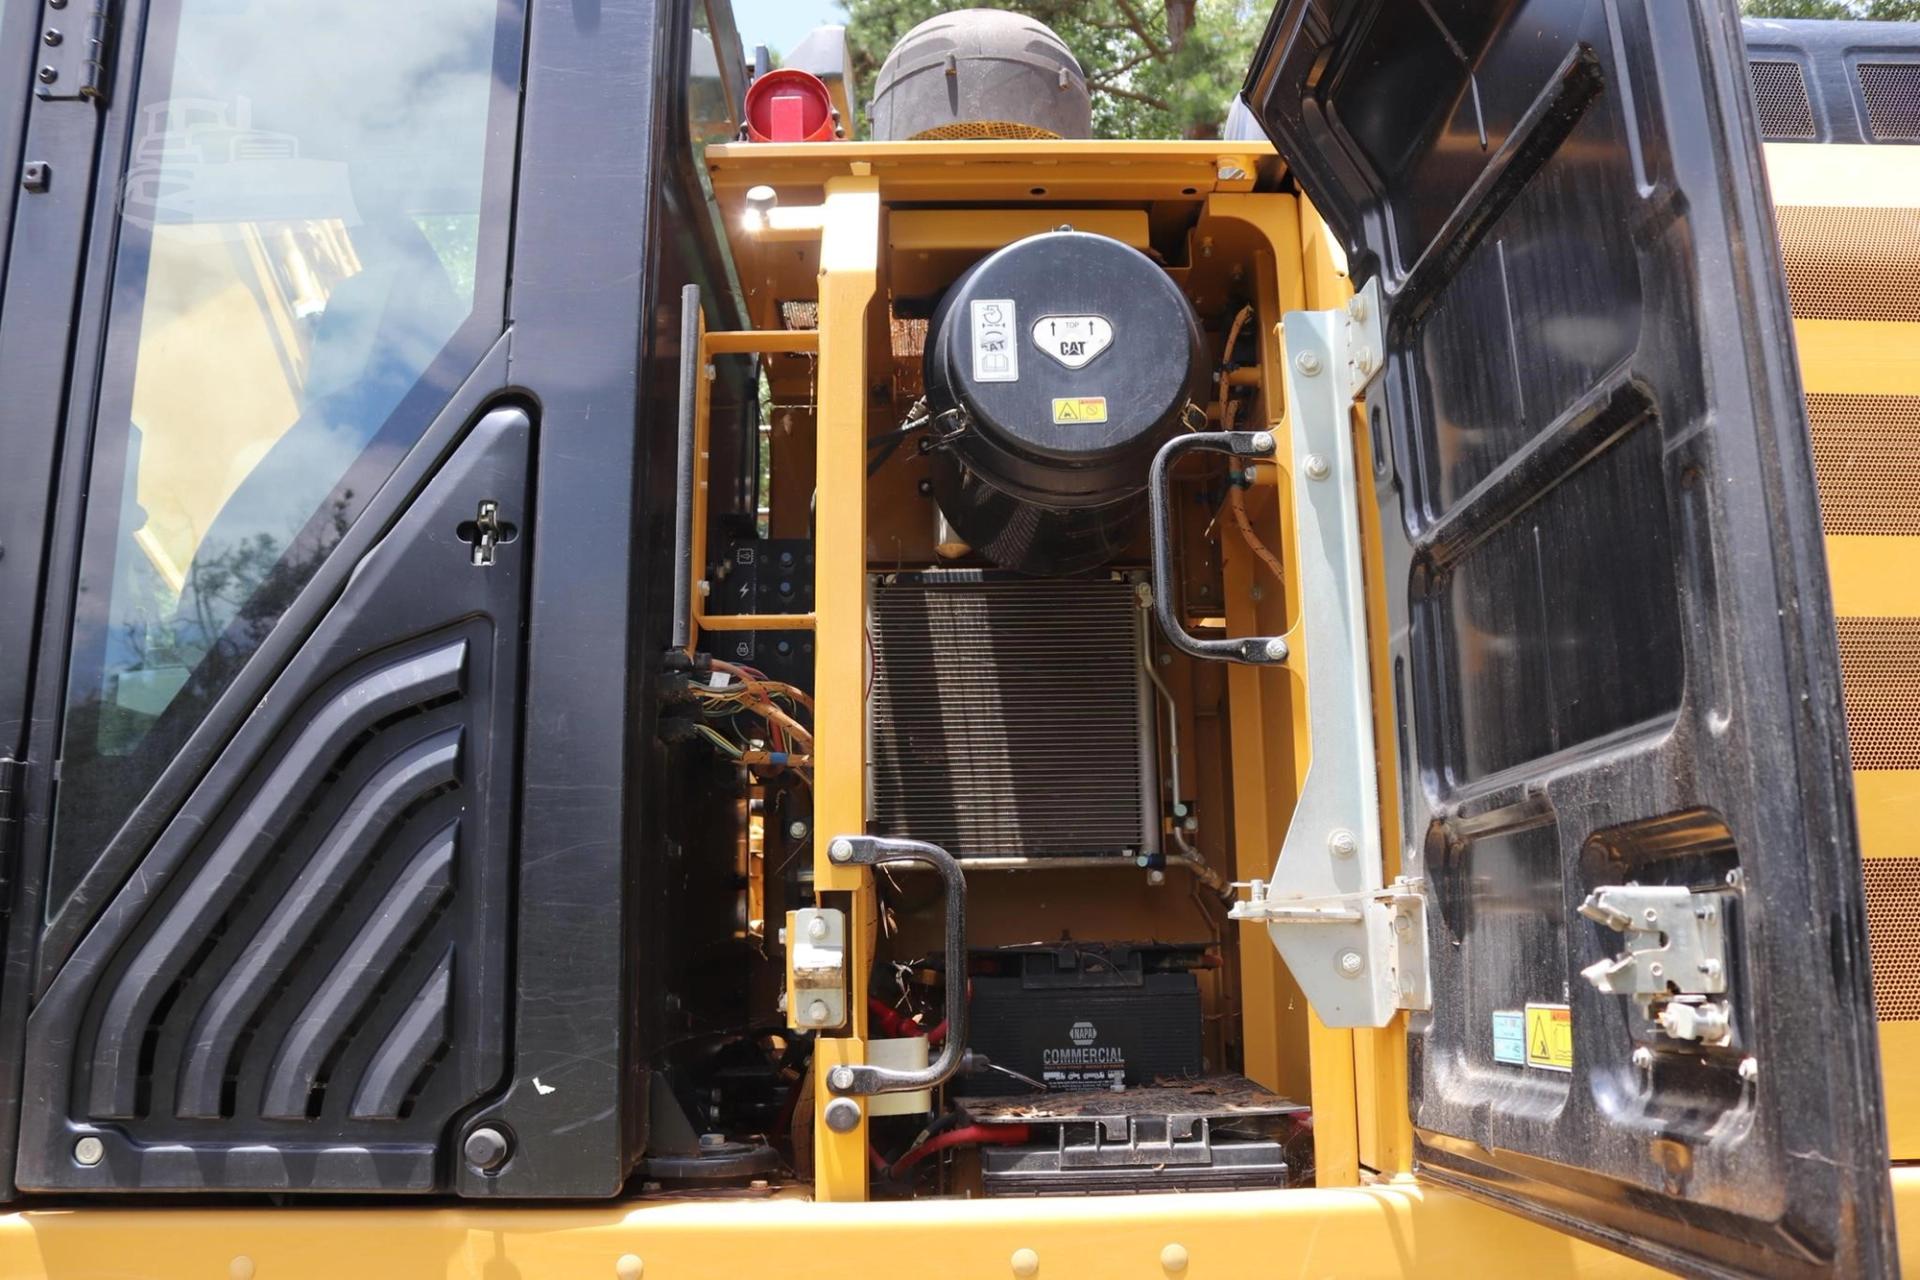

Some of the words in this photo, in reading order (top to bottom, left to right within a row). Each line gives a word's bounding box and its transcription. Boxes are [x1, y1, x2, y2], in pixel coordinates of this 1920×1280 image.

[1060, 342, 1086, 355] CAT
[1074, 1028, 1093, 1039] NAPA
[1043, 1047, 1125, 1064] COMMERCIAL
